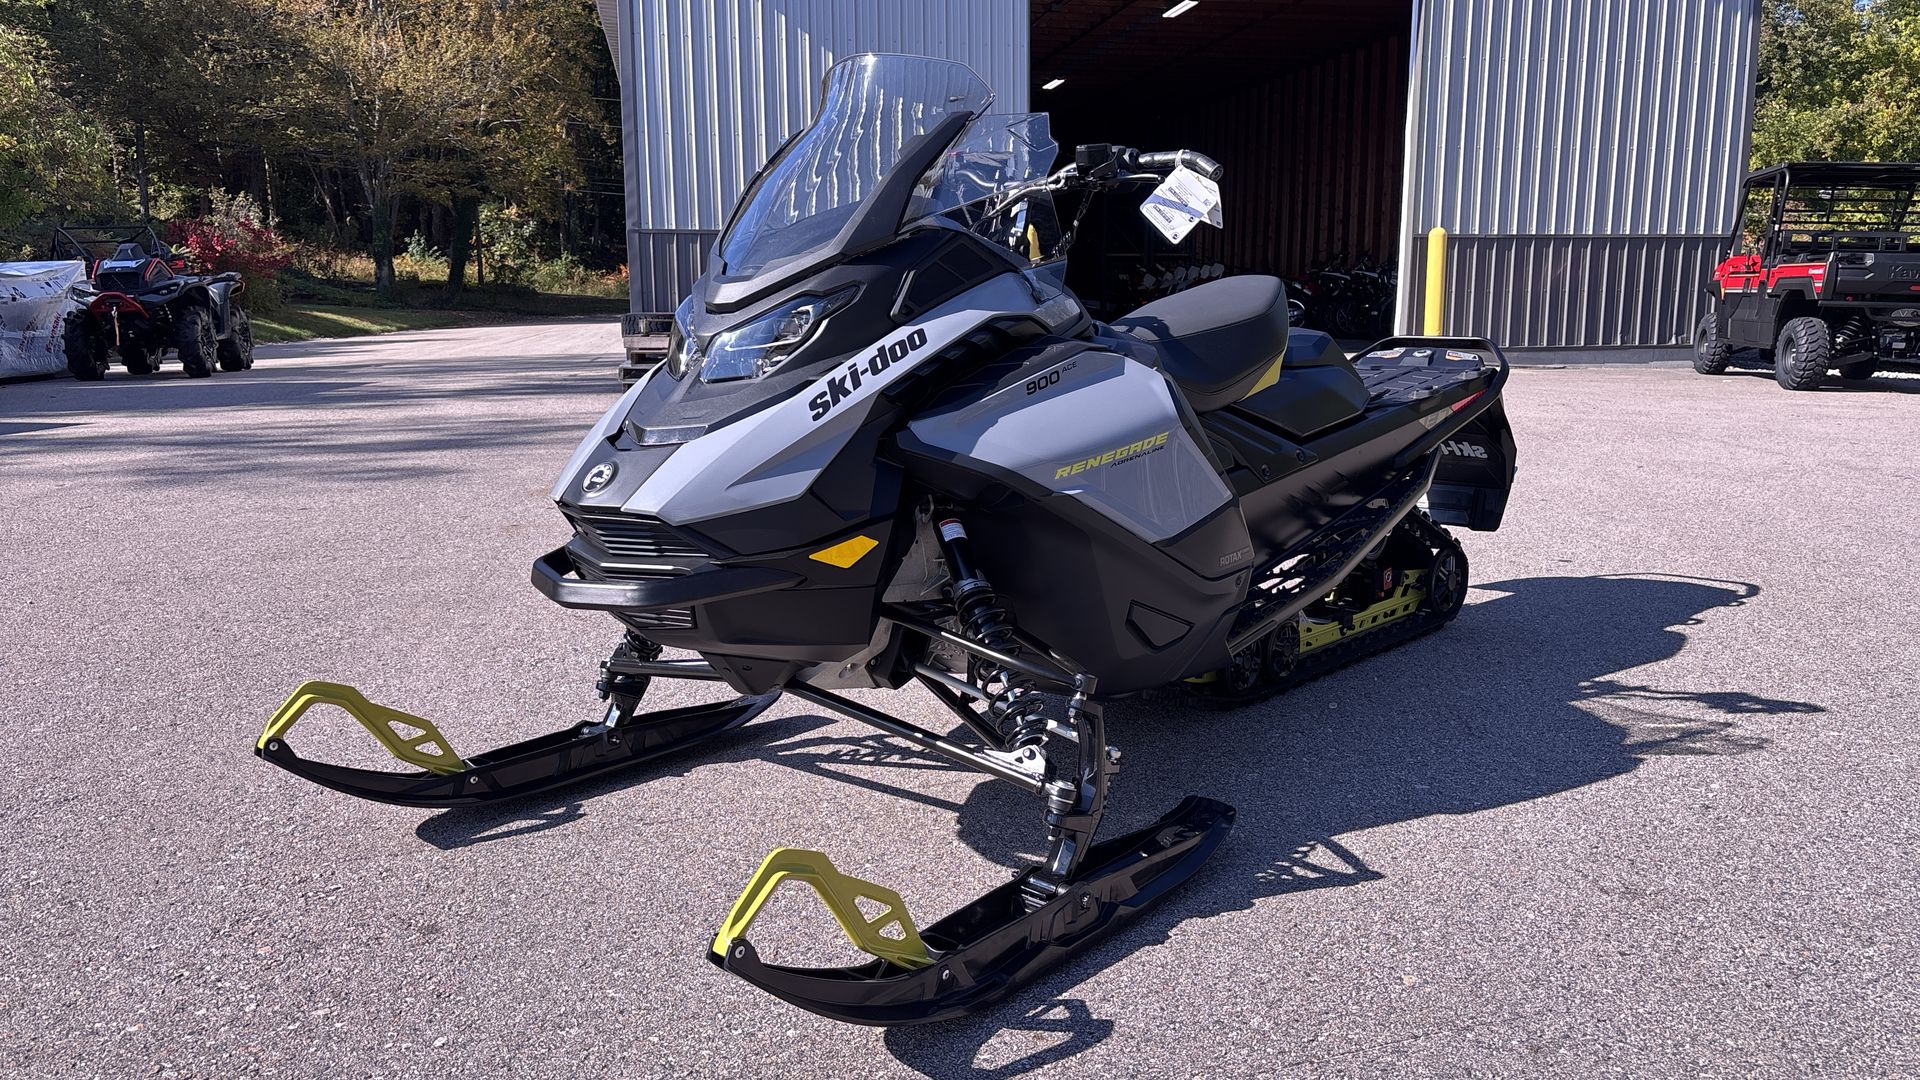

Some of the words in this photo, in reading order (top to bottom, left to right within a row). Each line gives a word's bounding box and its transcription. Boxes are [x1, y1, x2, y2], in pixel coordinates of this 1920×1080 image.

[1026, 370, 1060, 395] 900
[1062, 361, 1077, 374] ACE
[1054, 432, 1169, 480] RENEGADE
[1110, 445, 1165, 469] ADRENALINE
[1220, 550, 1242, 567] ROTAX
